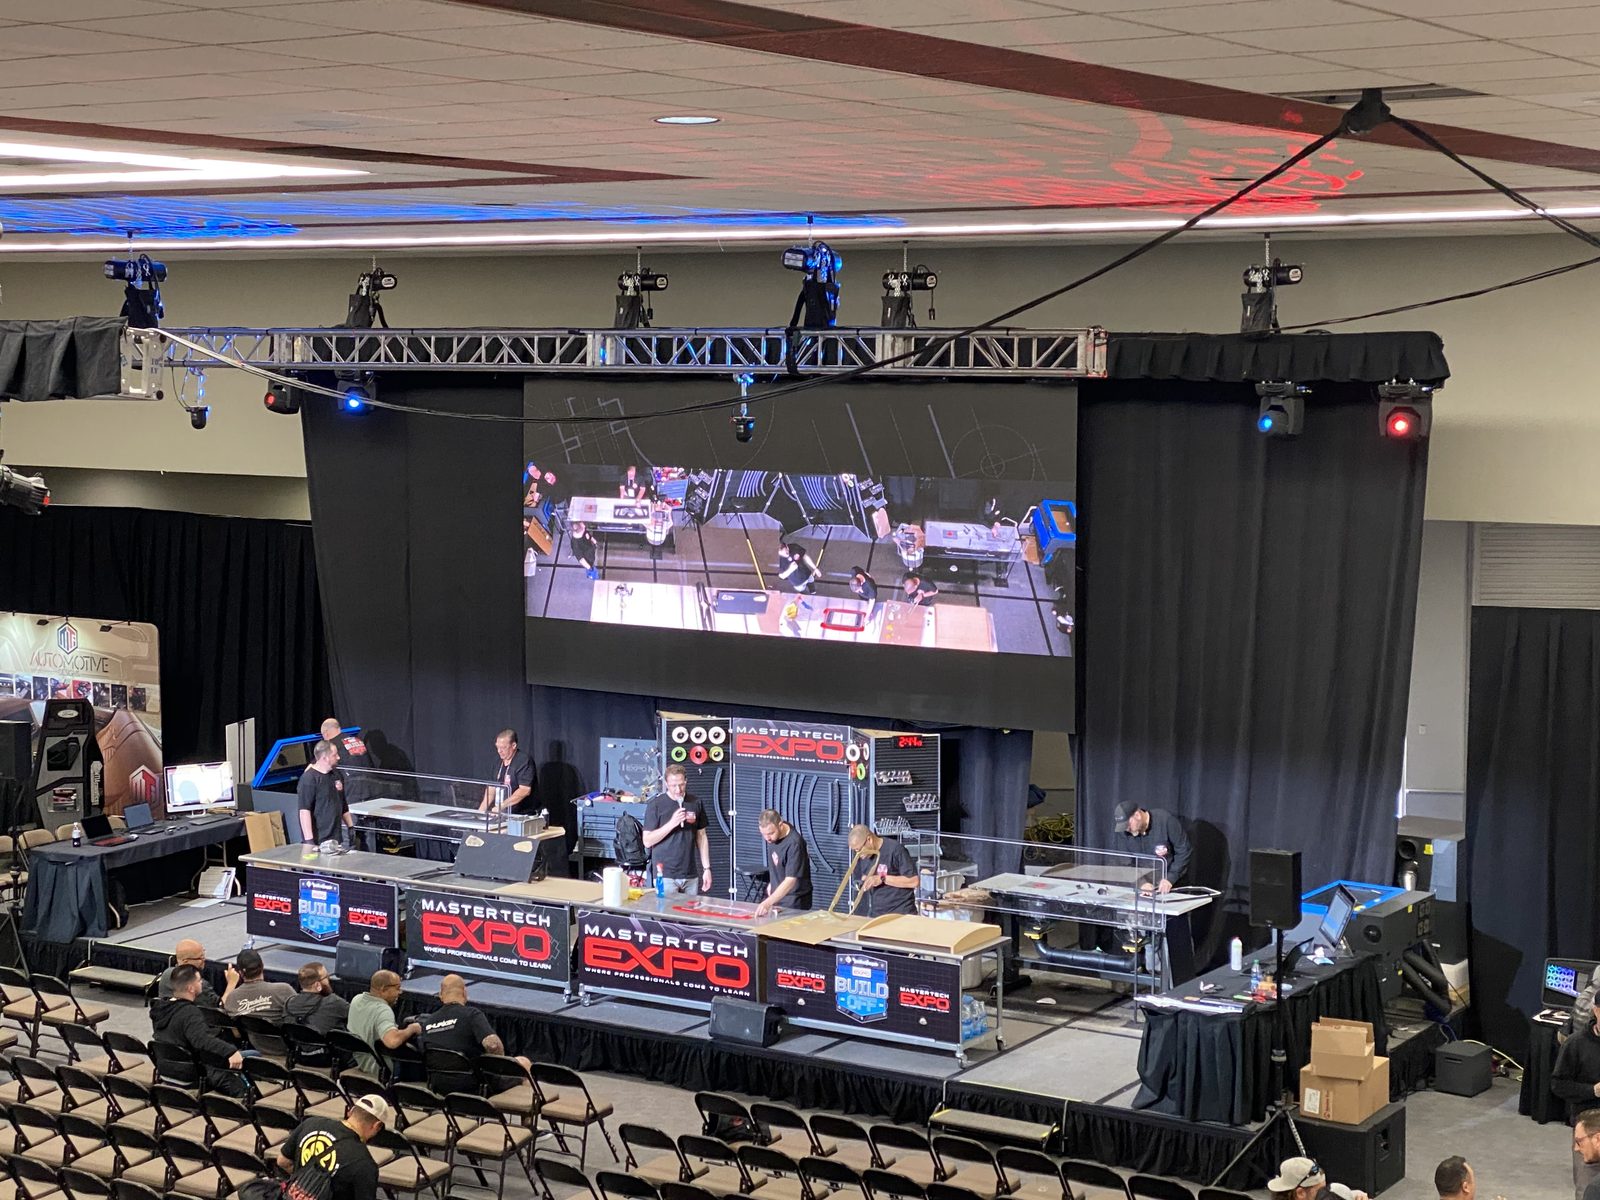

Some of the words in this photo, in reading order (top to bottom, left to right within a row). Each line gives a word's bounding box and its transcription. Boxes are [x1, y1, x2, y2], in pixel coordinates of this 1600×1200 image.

[29, 651, 110, 673] AUTOMOTIVE
[736, 733, 844, 761] EXPO
[756, 754, 800, 762] PROFESSIONALS
[254, 893, 292, 903] MASTERTECH
[254, 898, 292, 913] EXPO
[298, 899, 341, 919] BUILD
[348, 907, 387, 917] MASTERTECH
[421, 899, 550, 927] MASTERTECH
[308, 916, 331, 930] OFF
[348, 912, 388, 928] EXPO
[421, 912, 551, 961] EXPO
[584, 923, 749, 959] MASTERTECH
[424, 946, 446, 955] WHERE
[446, 949, 499, 962] PROFESSIONALS
[499, 957, 518, 966] COME
[518, 959, 529, 967] TO
[529, 961, 552, 970] LEARN
[583, 936, 750, 989] EXPO
[584, 967, 611, 976] WHERE
[614, 972, 681, 986] PROFESSIONALS
[683, 982, 706, 991] COME
[723, 988, 751, 997] LEARN
[776, 973, 826, 991] EXPO
[777, 968, 826, 980] MASTERTECH
[835, 975, 889, 999] BUILD
[899, 986, 950, 999] MASTERTECH
[846, 995, 878, 1012] OFF
[899, 992, 950, 1010] EXPO
